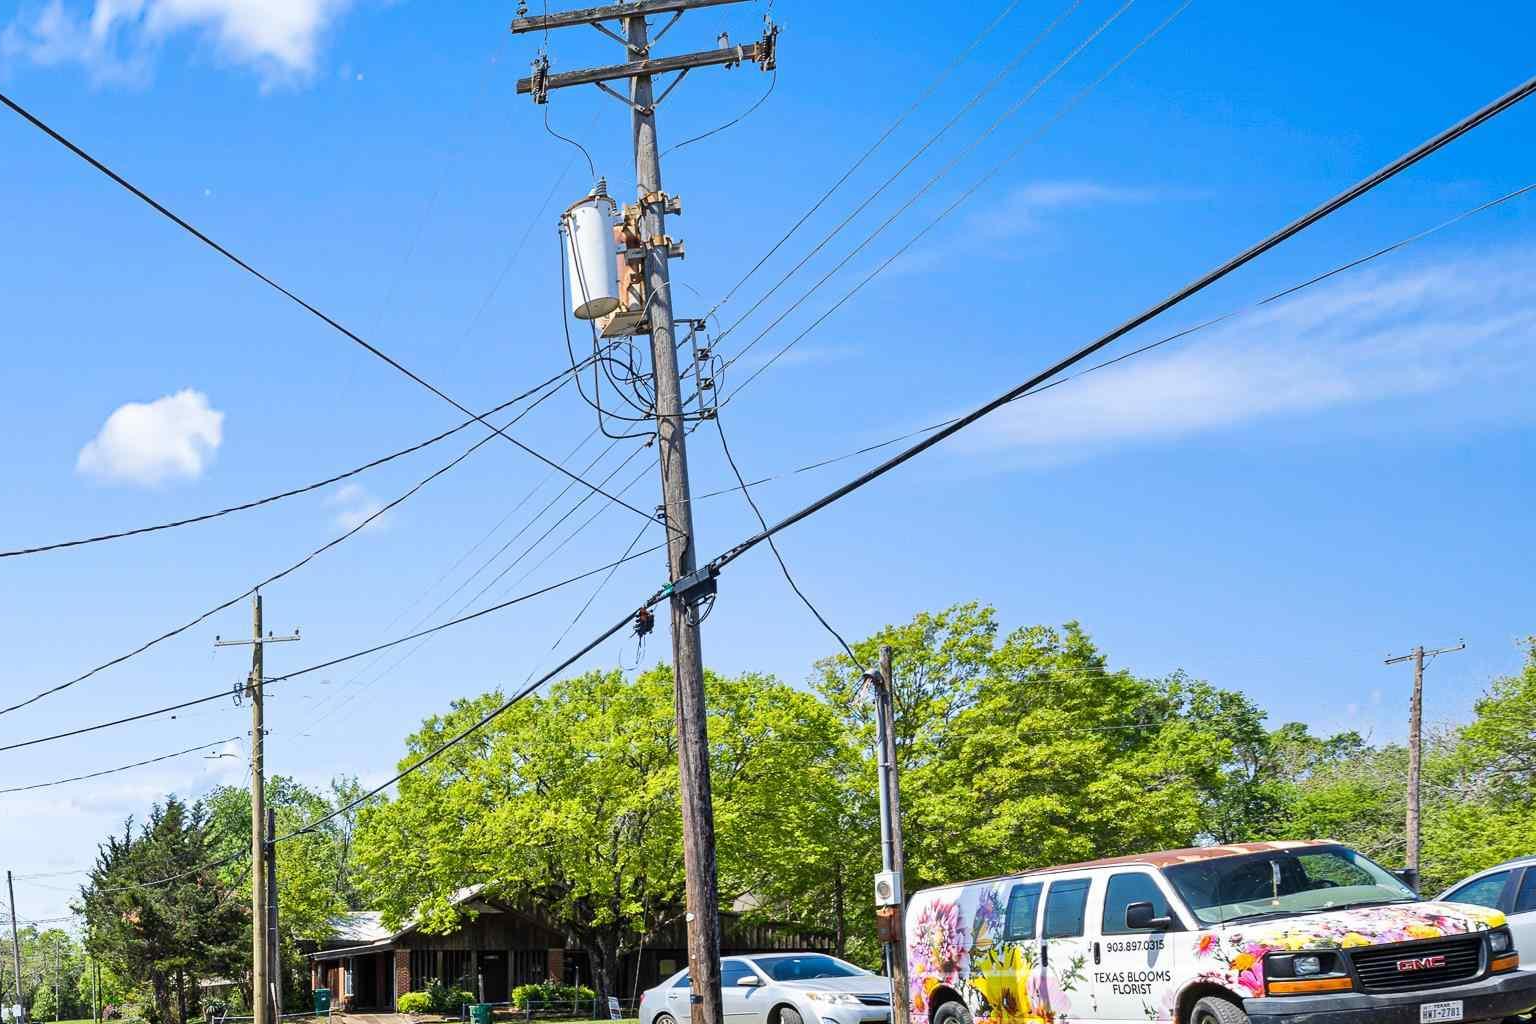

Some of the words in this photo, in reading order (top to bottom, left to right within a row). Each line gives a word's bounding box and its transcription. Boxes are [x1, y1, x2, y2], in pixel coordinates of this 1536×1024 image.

[1106, 940, 1165, 953] 903.897.0315
[1397, 955, 1445, 971] GMC
[1094, 971, 1125, 983] TEXAS
[1127, 970, 1171, 983] BLOOMS
[1112, 983, 1152, 995] FLORIST
